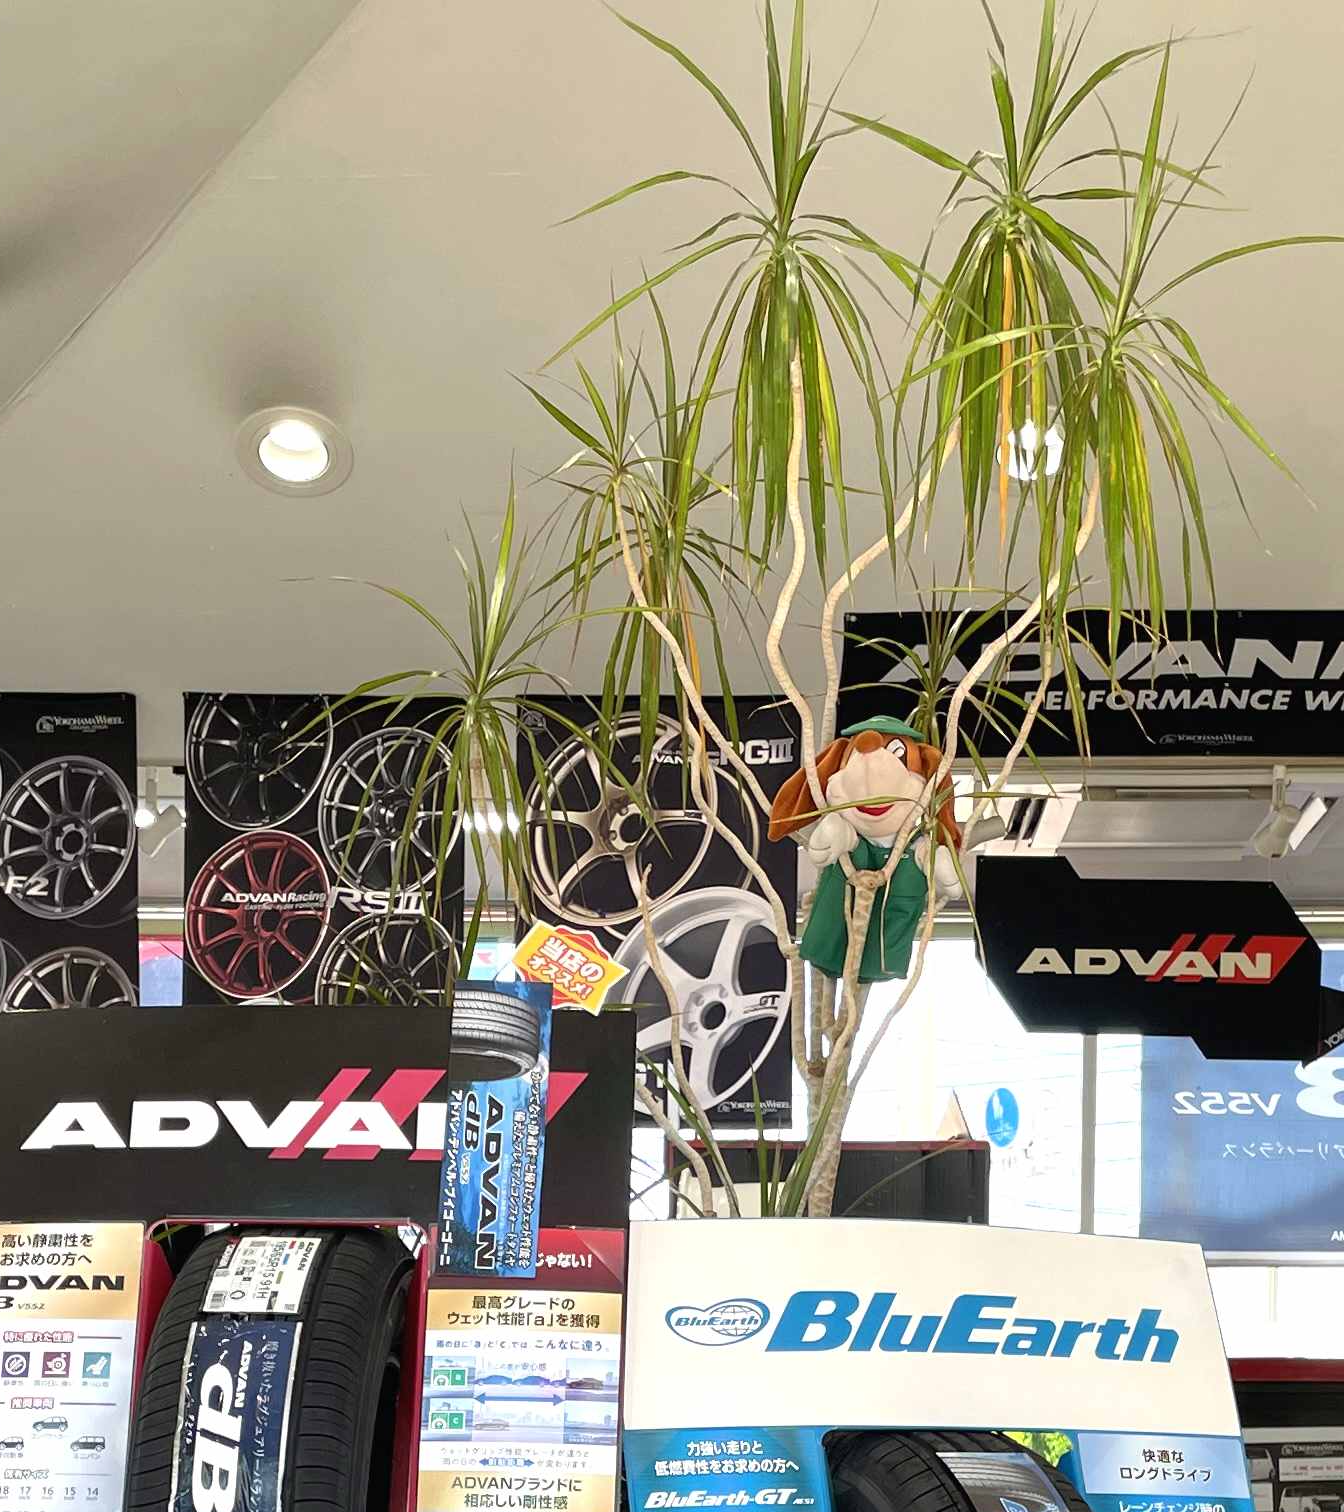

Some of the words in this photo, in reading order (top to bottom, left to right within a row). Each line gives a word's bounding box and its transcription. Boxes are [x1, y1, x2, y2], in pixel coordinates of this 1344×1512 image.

[1025, 688, 1291, 711] PERFORMANCE
[220, 892, 288, 903] ADVAN
[287, 891, 327, 902] Racing
[537, 937, 606, 984] 当店の
[1017, 948, 1274, 981] ADVAN
[20, 1099, 450, 1151] ADVA
[462, 1090, 483, 1152] dB
[474, 1094, 505, 1271] ADVAN
[1, 1232, 94, 1249] 高い静粛性を
[0, 1252, 93, 1268] お求めの方へ
[472, 1295, 576, 1311] 最高グレードの
[447, 1311, 601, 1330] ウェット性能「a」を獲得
[672, 1313, 763, 1331] BluEarth
[766, 1289, 1180, 1364] BluEarth
[234, 1339, 254, 1409] ADVAN
[686, 1439, 764, 1457] 力強い走りと
[1141, 1448, 1185, 1464] 快適な
[654, 1458, 800, 1477] 低燃費性をお求めの方へ
[1119, 1466, 1213, 1483] ロングドライブ
[451, 1476, 583, 1493] ADVANブランドに
[463, 1493, 569, 1511] 相応しい剛性感
[644, 1487, 798, 1510] BluEarth-GT
